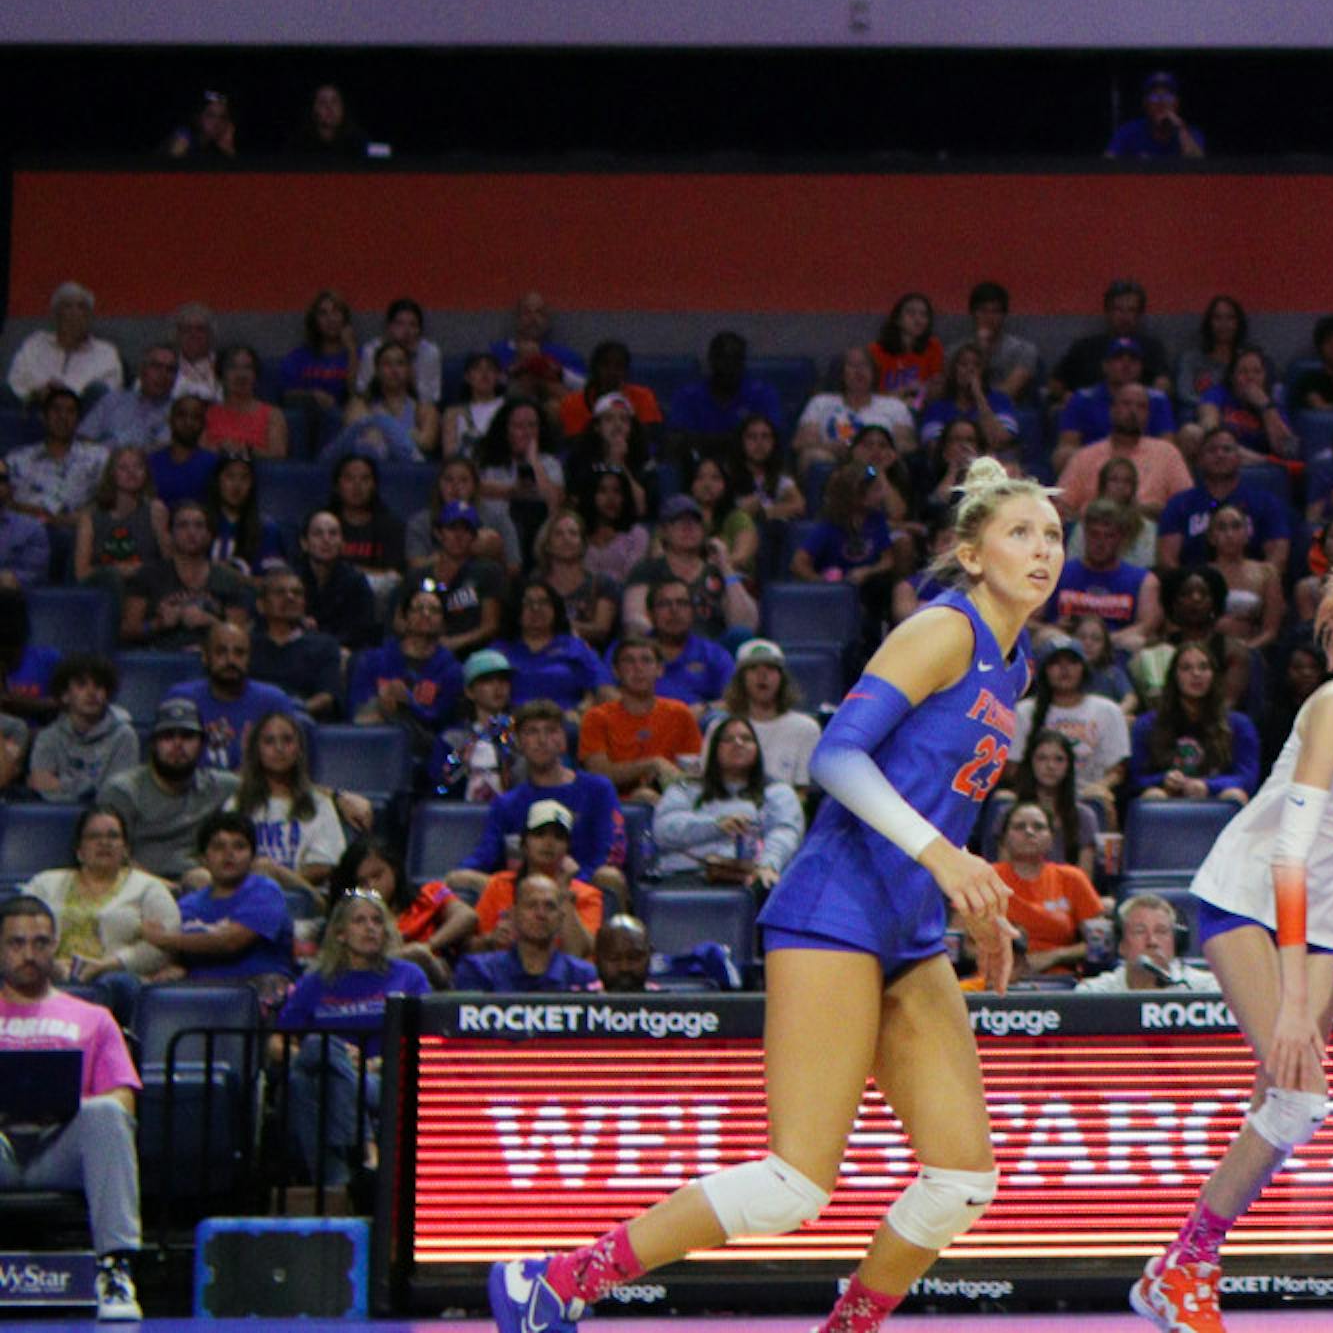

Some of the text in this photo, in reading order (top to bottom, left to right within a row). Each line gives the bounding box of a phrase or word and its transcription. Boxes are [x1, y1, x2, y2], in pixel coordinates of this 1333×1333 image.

[459, 1005, 719, 1037] ROCKET Mortgage
[969, 1006, 1061, 1036] rtgage
[927, 1277, 1014, 1299] Mortgage
[1218, 1275, 1271, 1292] CKET
